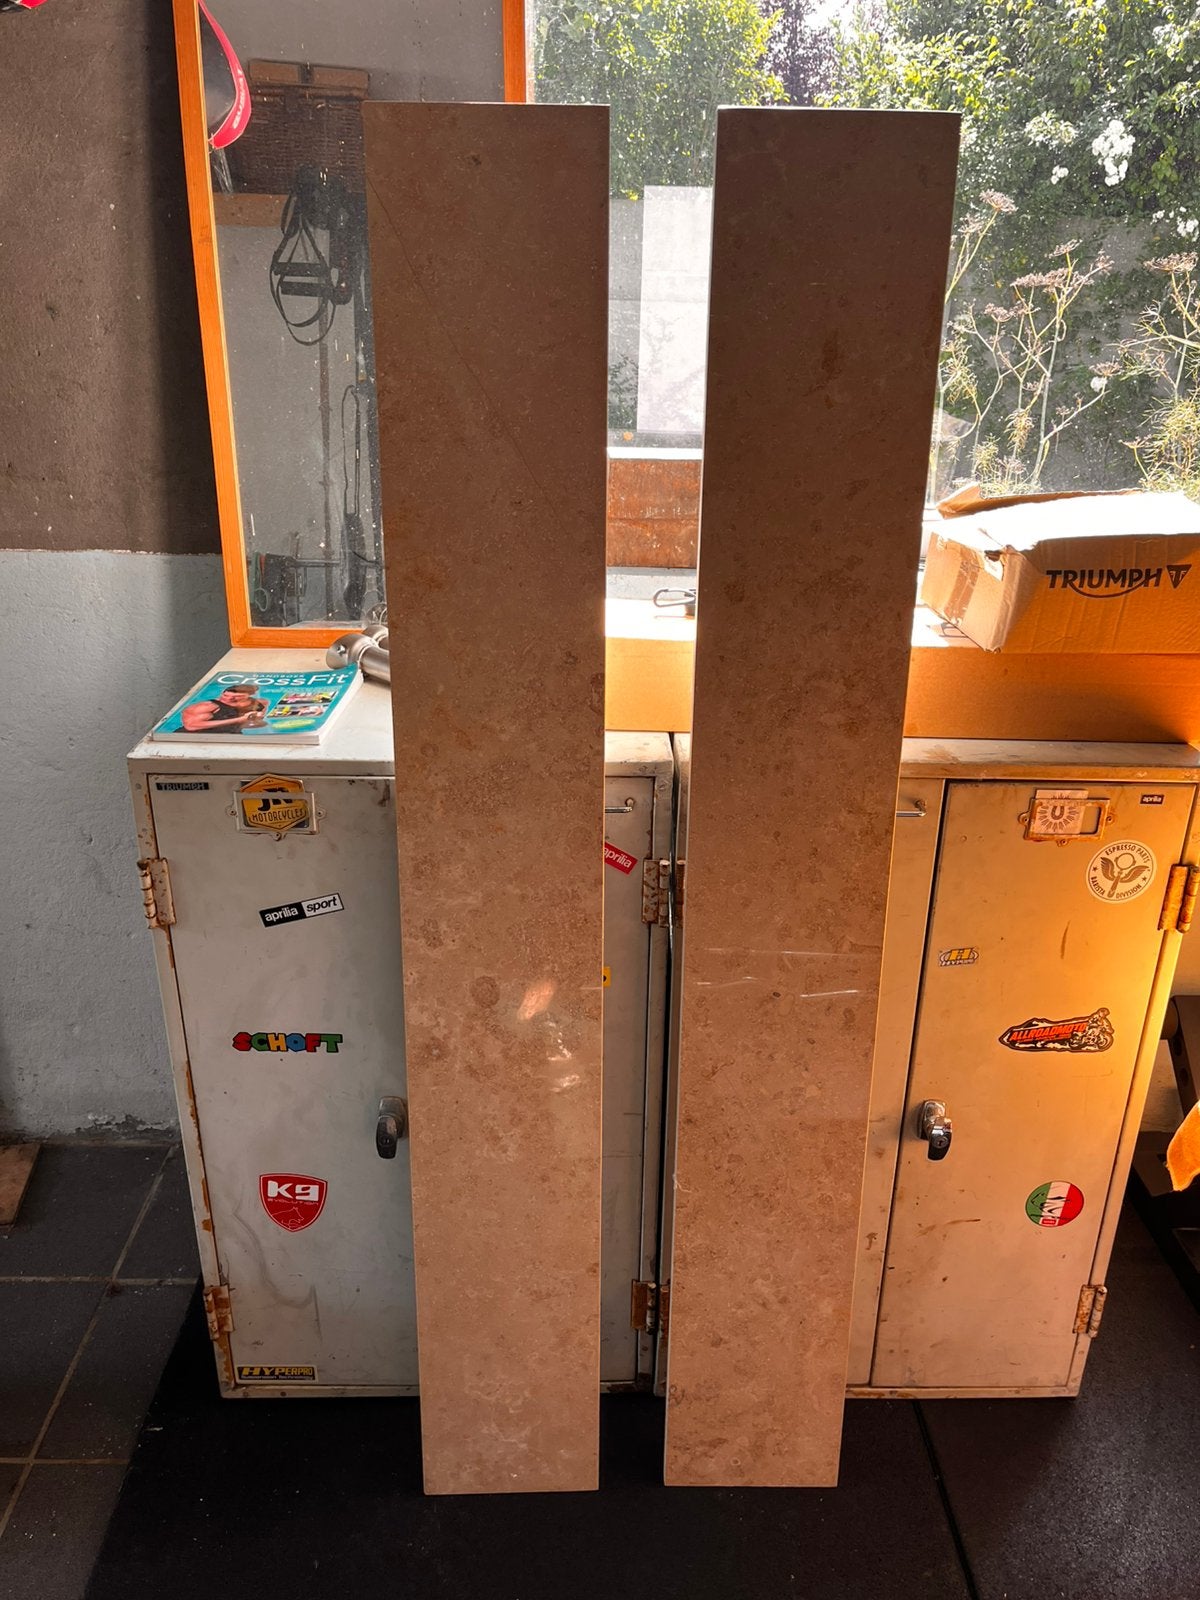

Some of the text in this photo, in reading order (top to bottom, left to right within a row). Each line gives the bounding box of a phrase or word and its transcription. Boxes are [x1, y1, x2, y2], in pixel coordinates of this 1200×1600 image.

[1046, 568, 1163, 598] TRIUMPH
[217, 673, 347, 686] CrossFit
[604, 847, 632, 868] aprilia
[1105, 844, 1136, 855] ESPRESSO
[1091, 876, 1142, 898] BARISTA DIVISION
[265, 897, 337, 922] aprilia sport
[1009, 1022, 1087, 1041] ALLROADMOTO
[232, 1032, 343, 1053] SCHOFT
[267, 1180, 319, 1202] K9
[242, 1367, 313, 1376] HYPERPRO
